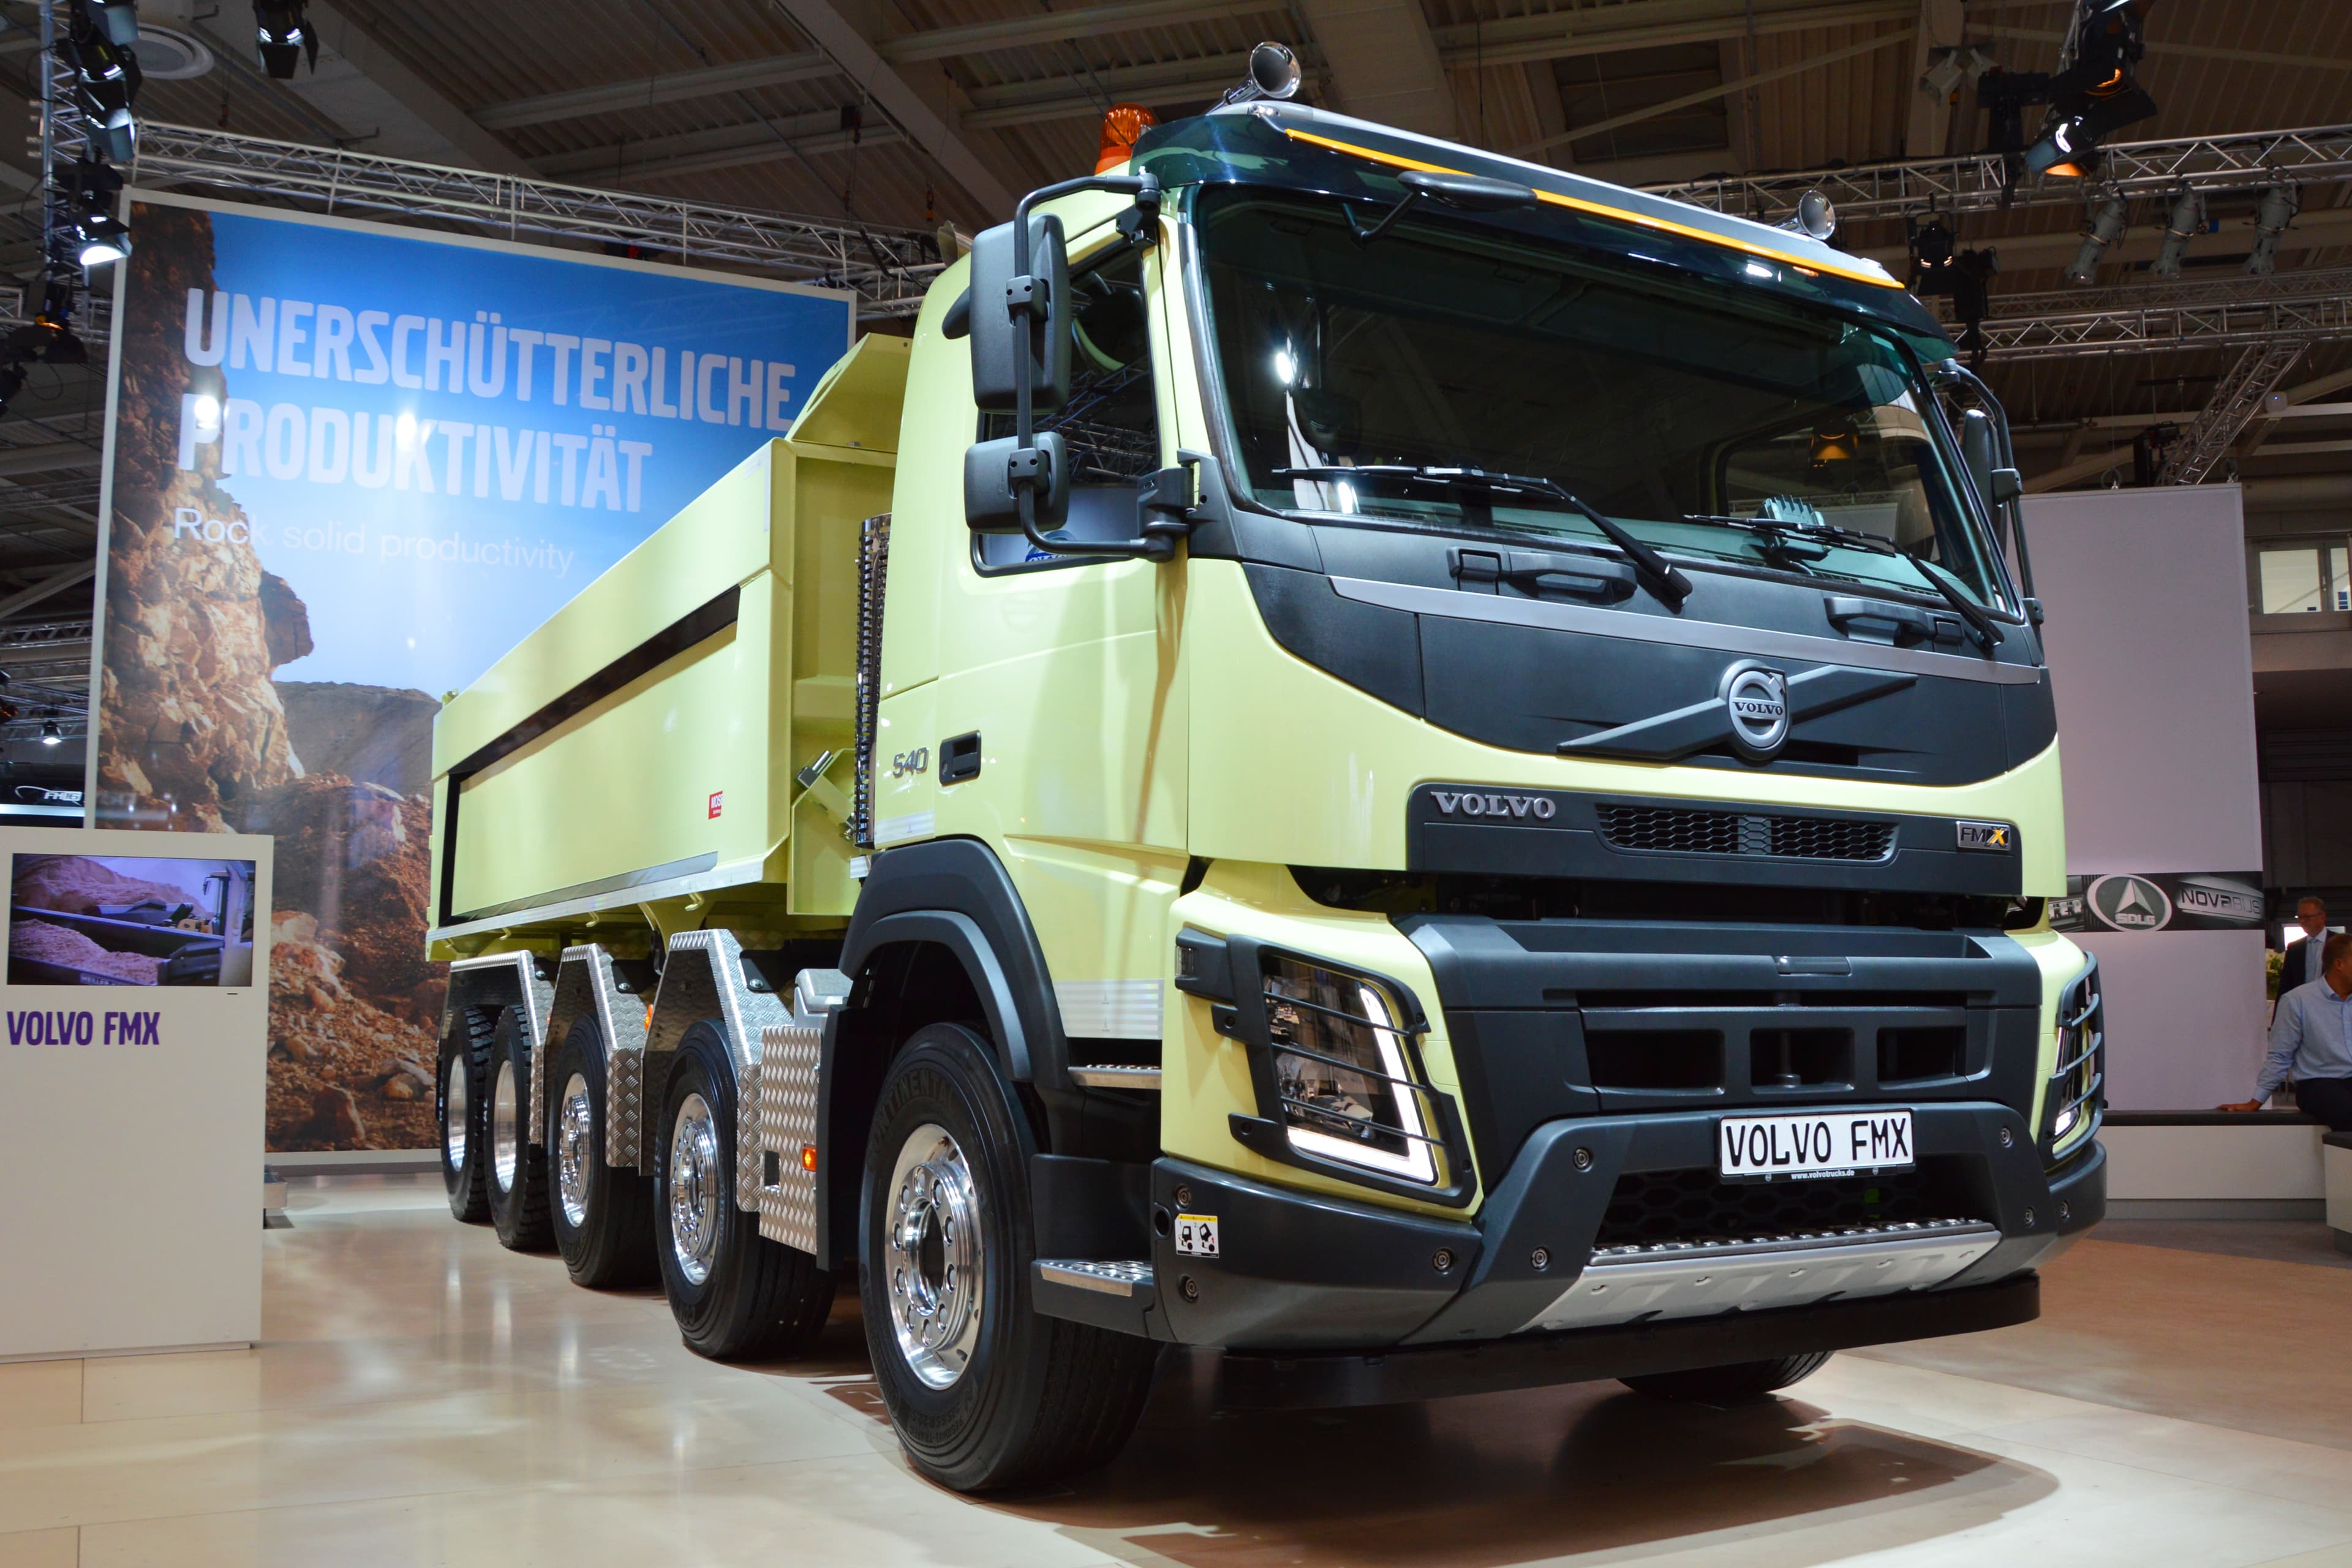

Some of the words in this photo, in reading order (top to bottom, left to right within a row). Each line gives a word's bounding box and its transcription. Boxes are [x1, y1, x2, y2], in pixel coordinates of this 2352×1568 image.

[183, 287, 796, 432] UNERSCHÜTTERLICHE
[178, 393, 652, 513] PRODUKTIVITÄT
[174, 507, 270, 546] Rock
[282, 520, 366, 554] solid
[380, 531, 575, 579] productivity
[1733, 701, 1784, 716] VOLVO
[892, 747, 929, 778] 540
[1430, 791, 1556, 819] VOLVO
[1961, 826, 2007, 848] FMX
[2116, 912, 2156, 926] SDLG
[7, 1011, 94, 1046] VOLVO
[103, 1011, 161, 1046] FMX
[1725, 1121, 1832, 1167] VOLVO
[1850, 1118, 1909, 1161] FMX
[1791, 1169, 1855, 1180] www.volvotrucks.de
